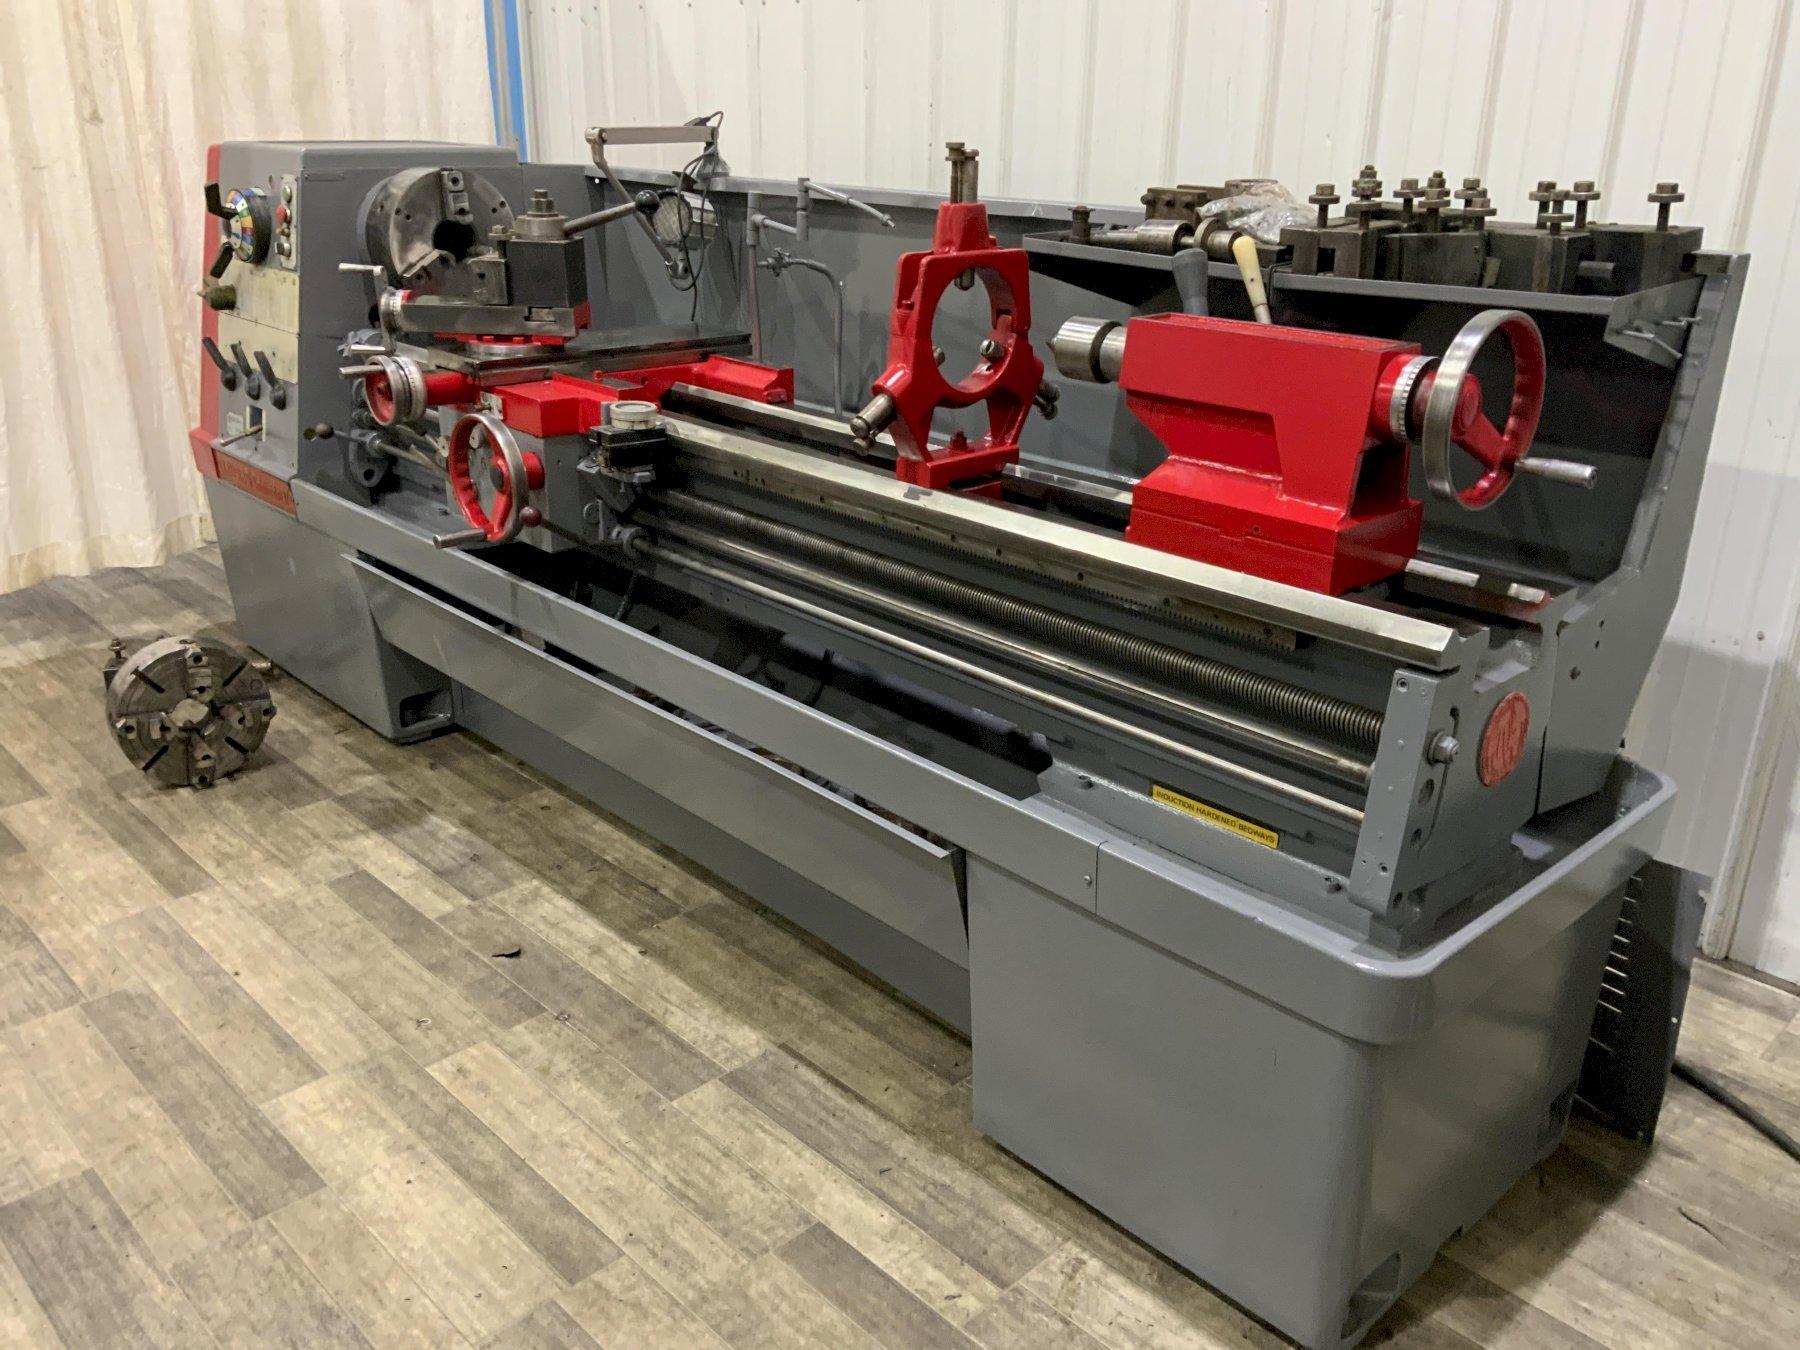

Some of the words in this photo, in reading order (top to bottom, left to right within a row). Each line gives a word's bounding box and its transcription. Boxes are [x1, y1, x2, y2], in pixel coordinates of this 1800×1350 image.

[1156, 790, 1195, 812] INDUCTION
[1195, 806, 1237, 827] HARDENED
[1238, 823, 1276, 843] BEDWAYS
